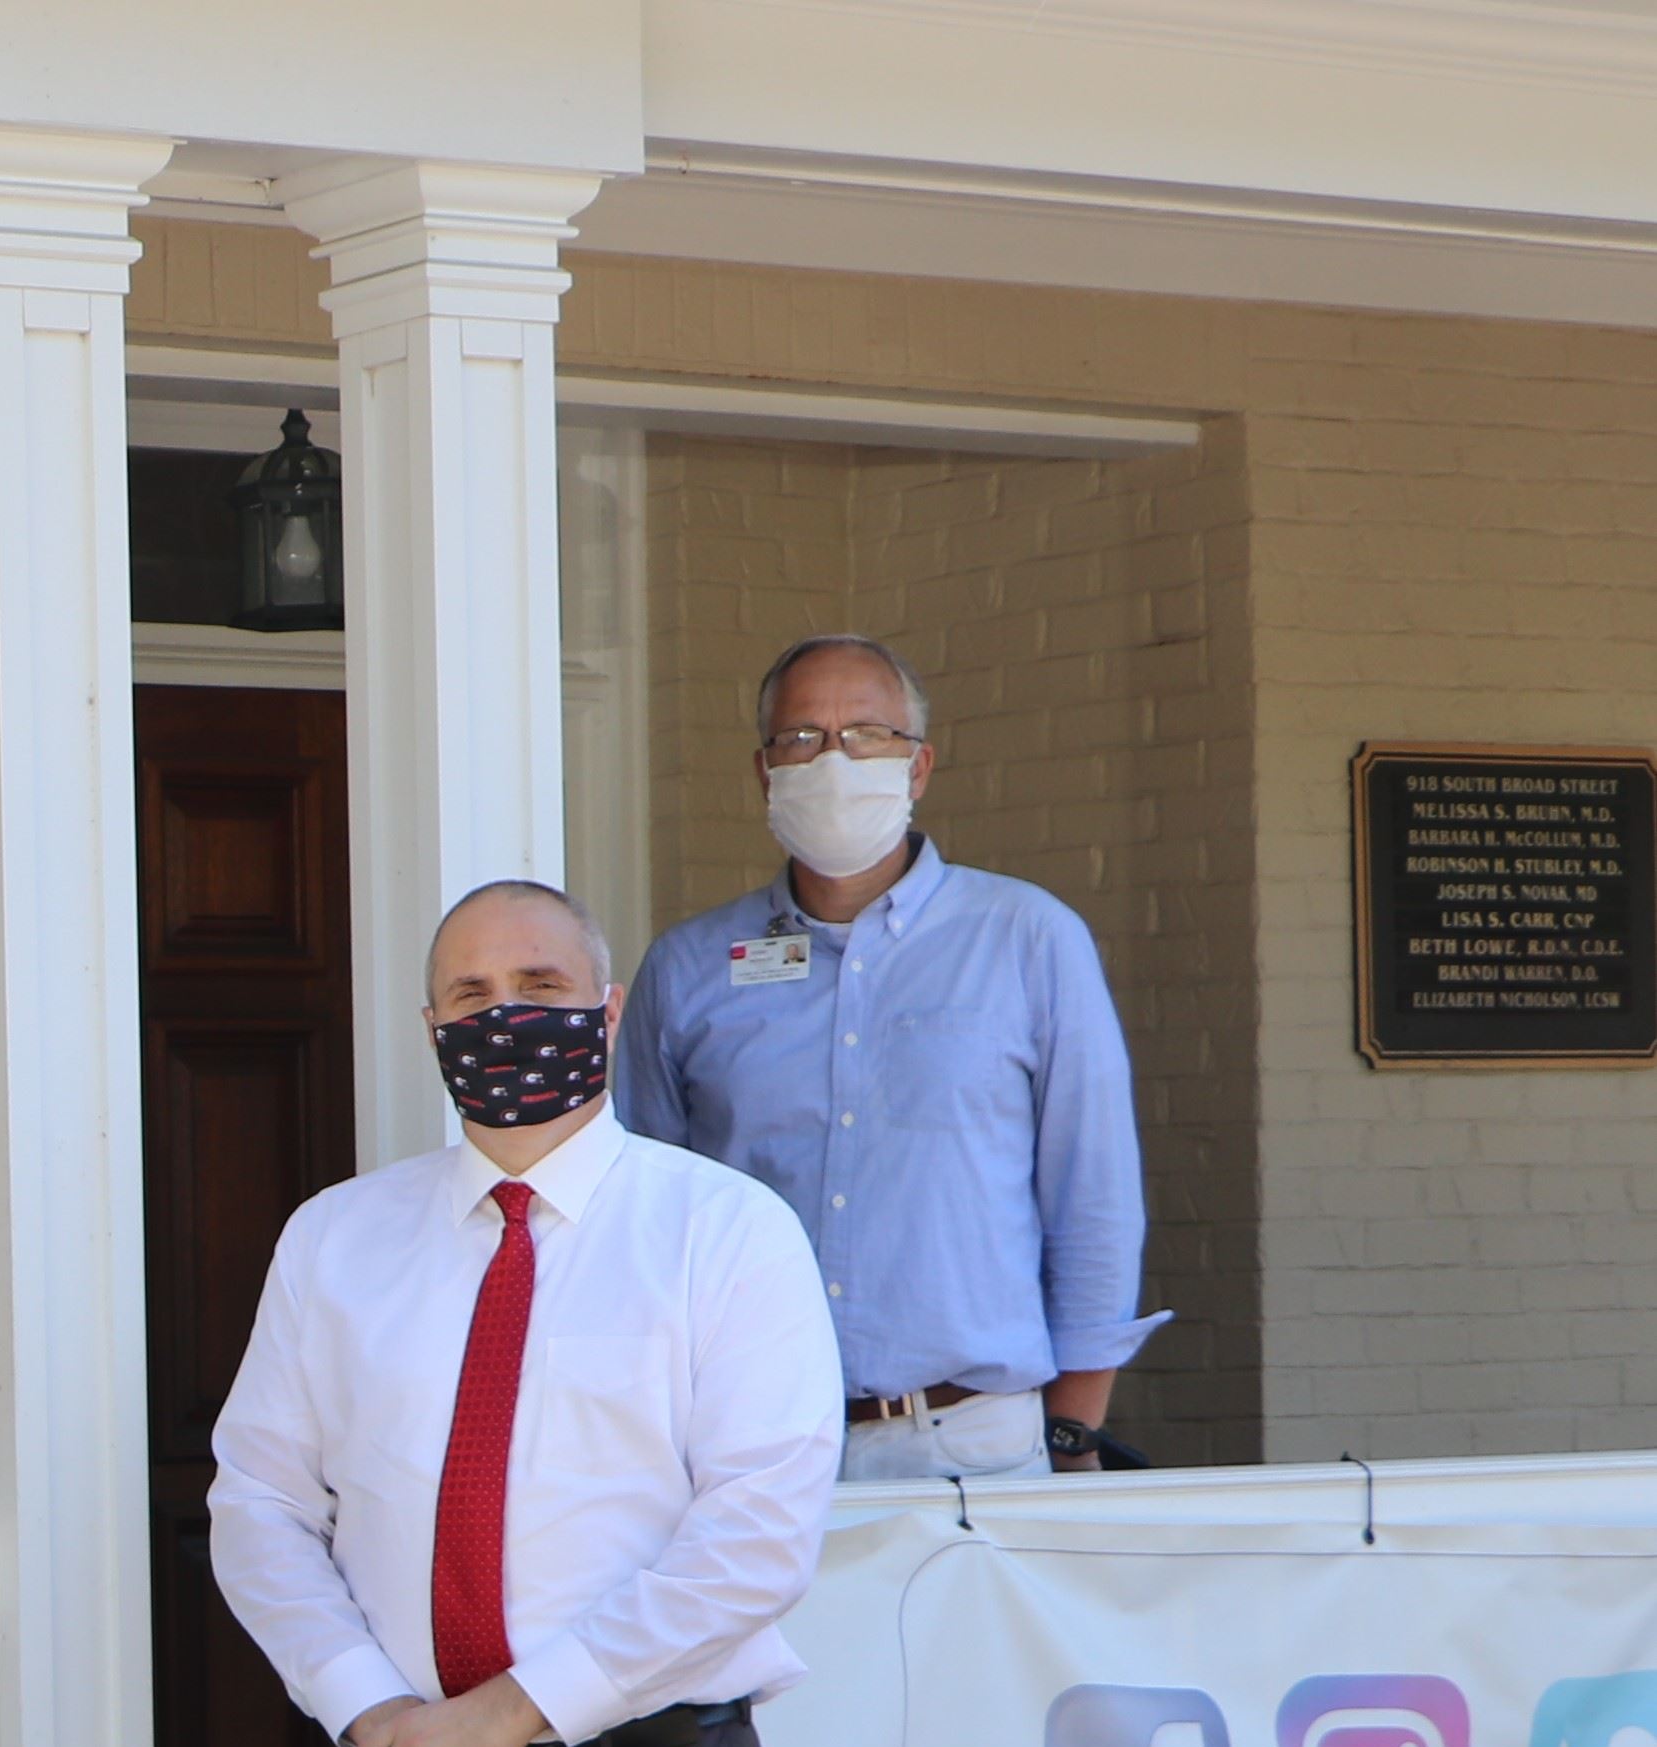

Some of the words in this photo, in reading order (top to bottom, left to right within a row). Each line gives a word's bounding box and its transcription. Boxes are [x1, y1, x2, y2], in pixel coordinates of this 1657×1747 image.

[1407, 776, 1438, 791] 918
[1443, 776, 1496, 792] SOUTH
[1502, 778, 1555, 793] BROAD
[1560, 779, 1617, 794] STREET
[1413, 803, 1489, 819] MELISSA
[1494, 804, 1510, 820] S.
[1581, 807, 1615, 822] M.D.
[1409, 830, 1480, 846] BARBARA
[1590, 833, 1620, 848] M.D.
[1407, 857, 1489, 873] ROBINSON
[1590, 860, 1622, 876] M.D.
[1437, 884, 1497, 900] JOSEPH
[1502, 885, 1516, 900] S.
[1576, 886, 1597, 902] MD
[1442, 912, 1483, 927] LISA
[1488, 912, 1505, 928] S.
[1510, 912, 1559, 929] CARR,
[1409, 939, 1457, 955] BETH
[1464, 939, 1521, 957] LOWE,
[1438, 965, 1498, 981] BRANDI
[1413, 992, 1494, 1008] ELIZABETH
